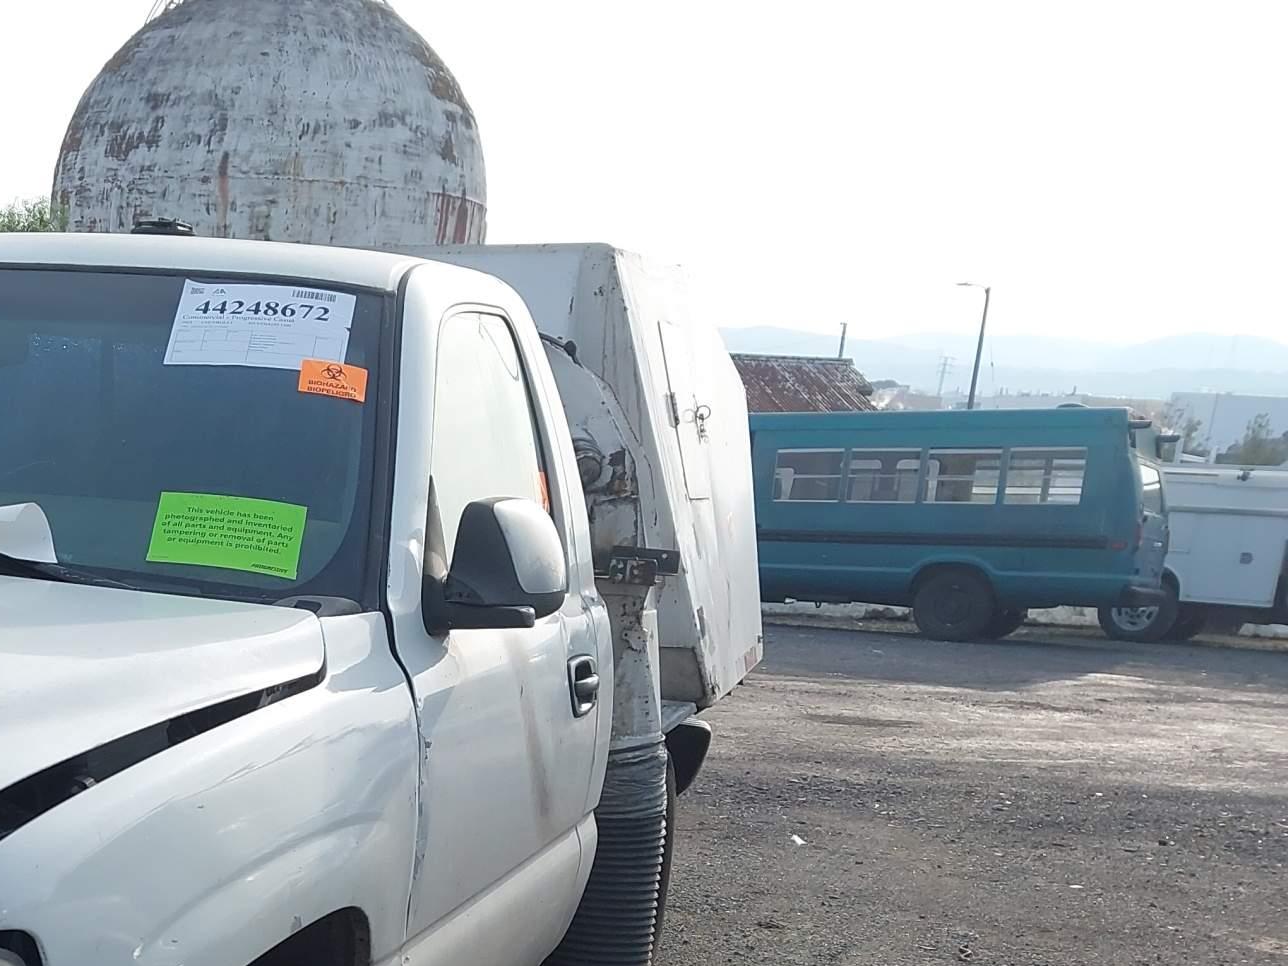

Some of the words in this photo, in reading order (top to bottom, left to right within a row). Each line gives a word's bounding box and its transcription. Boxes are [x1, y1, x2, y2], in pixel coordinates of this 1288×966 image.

[195, 299, 330, 321] 44248672
[165, 513, 225, 523] photographed
[245, 519, 293, 532] inventoried
[206, 508, 234, 516] vehicle
[253, 513, 274, 521] been
[163, 528, 207, 538] tampering
[220, 533, 254, 542] removal
[267, 539, 289, 548] parts
[226, 526, 275, 538] equipment.
[277, 532, 294, 542] Any
[178, 537, 224, 547] equipment
[235, 543, 281, 554] prohibited.
